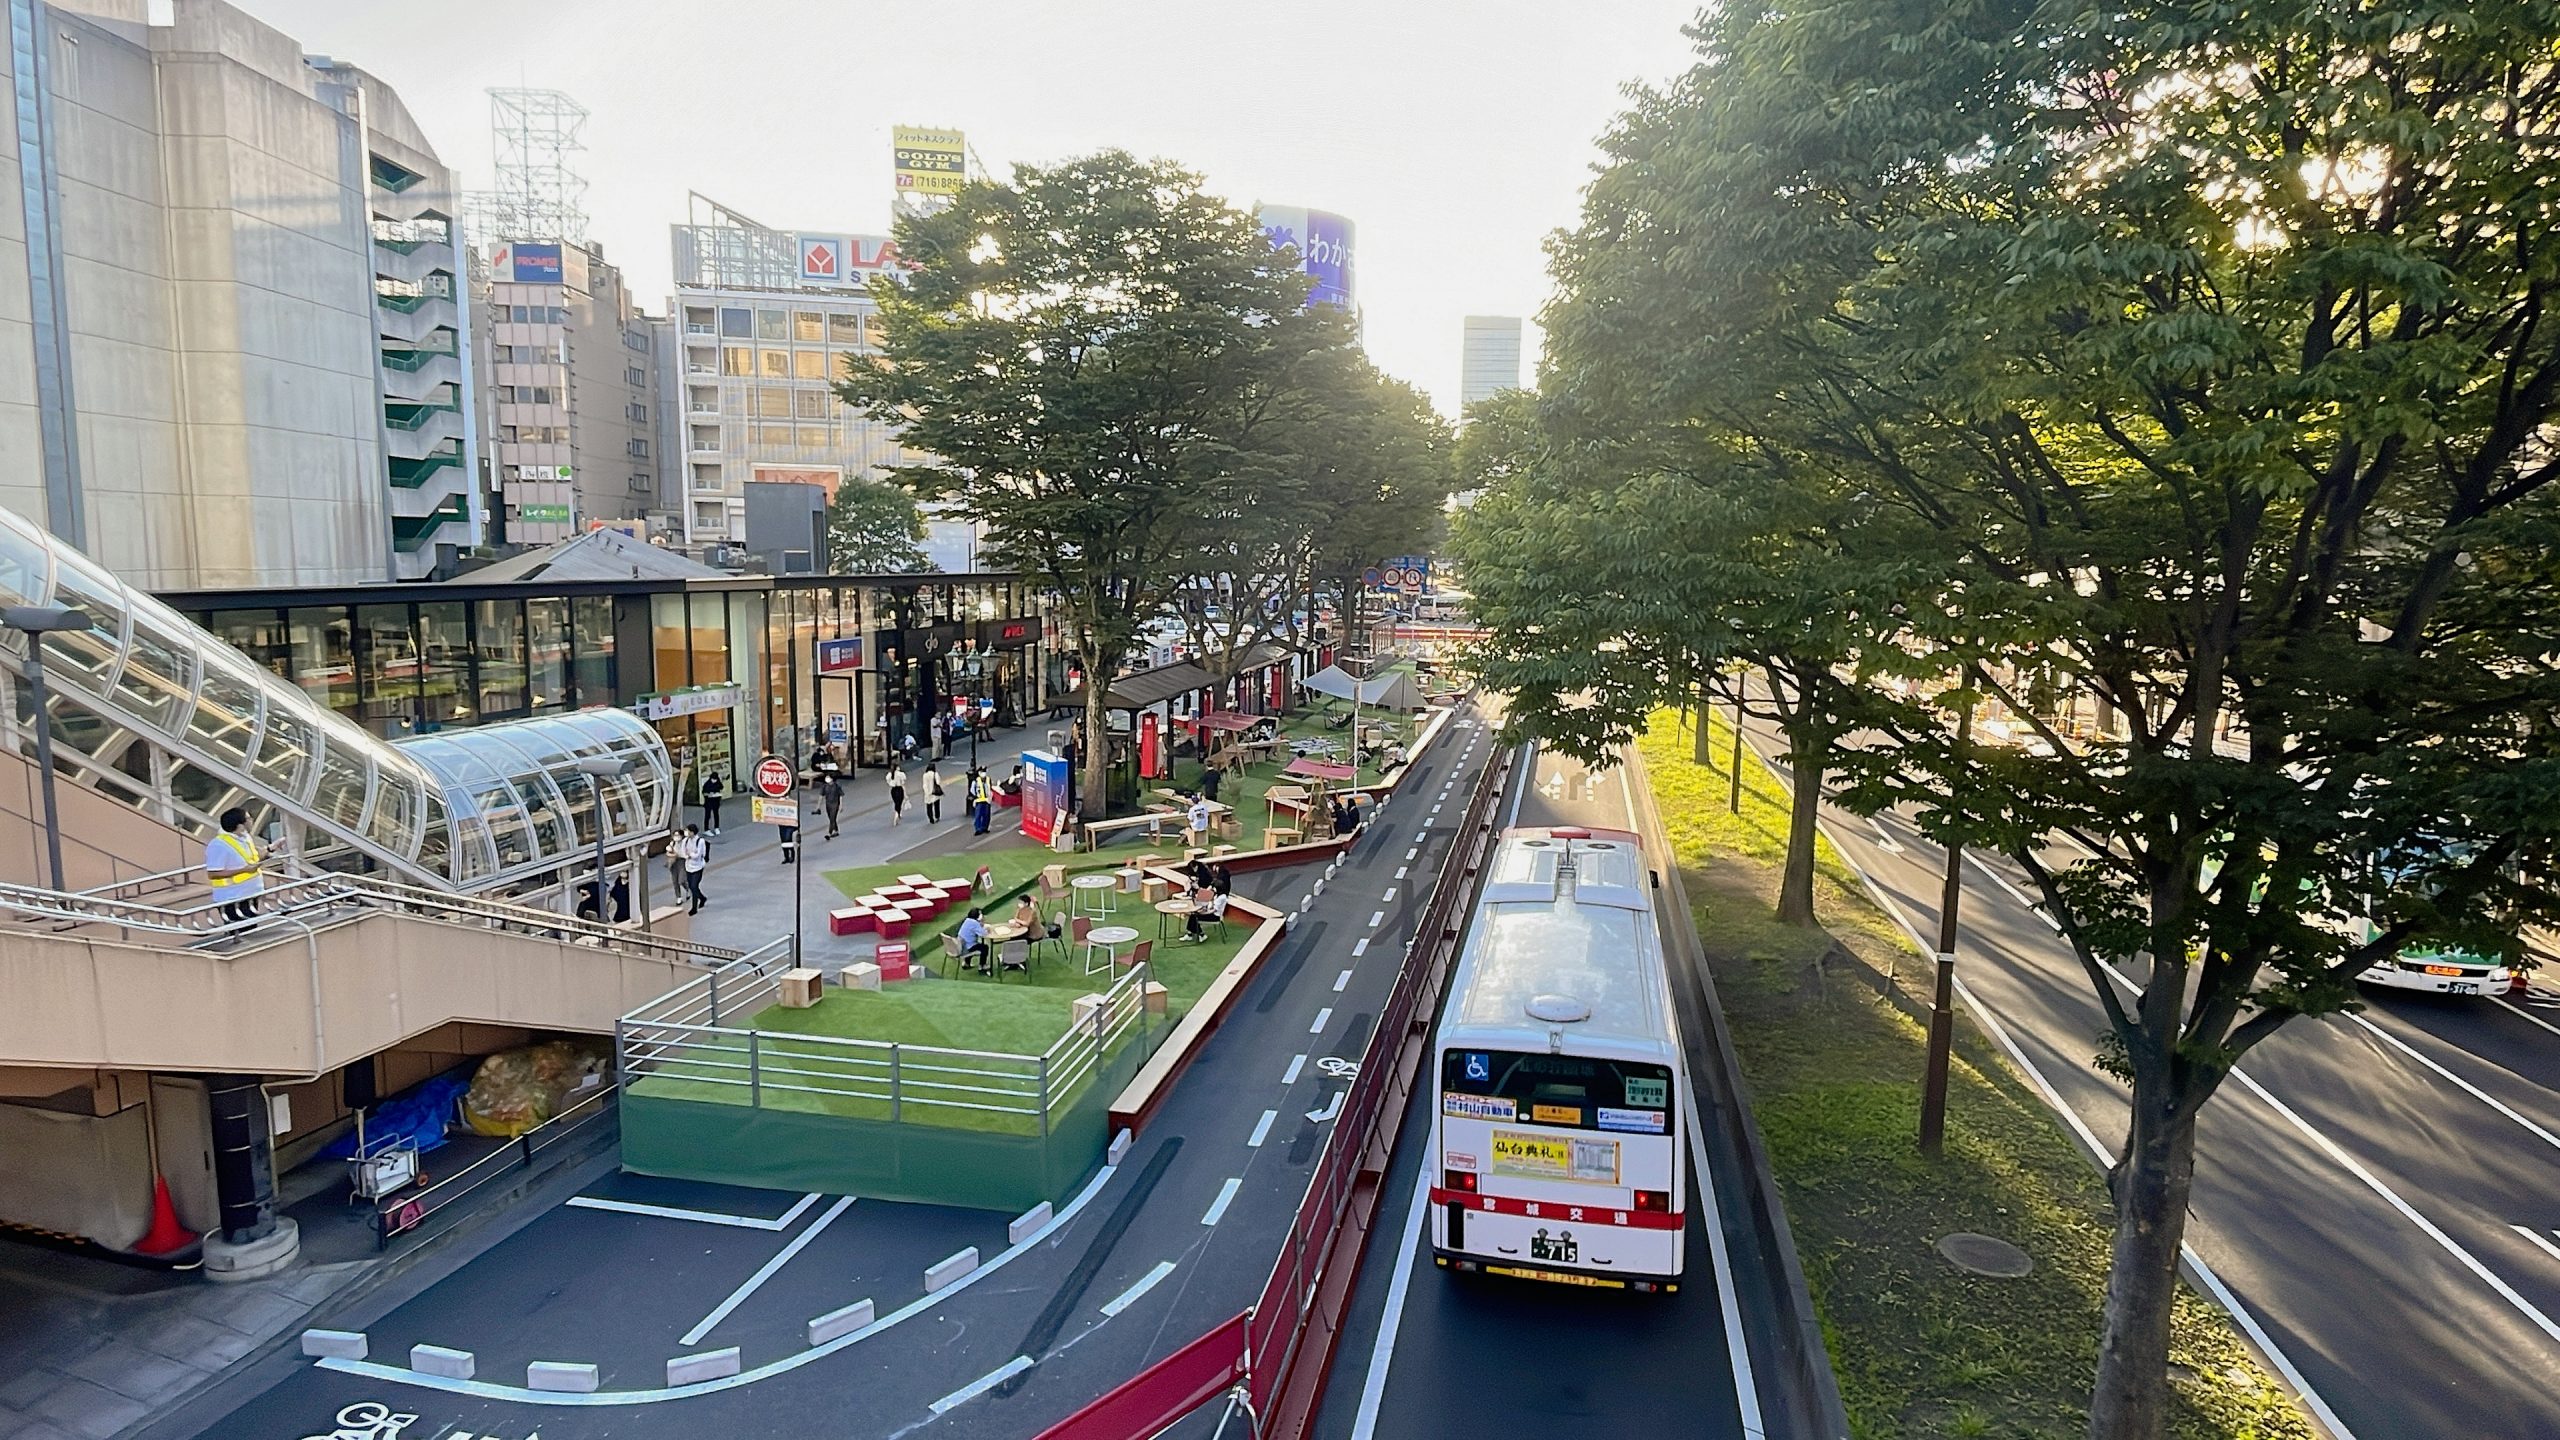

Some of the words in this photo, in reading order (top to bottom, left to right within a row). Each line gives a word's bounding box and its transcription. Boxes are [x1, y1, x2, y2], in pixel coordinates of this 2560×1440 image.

[897, 134, 961, 145] フィットネスクラブ
[896, 151, 962, 163] GOLD'S
[908, 160, 952, 170] GYM
[898, 174, 913, 186] 7F
[761, 770, 788, 787] 消火栓
[1495, 1141, 1554, 1159] 仙台典礼
